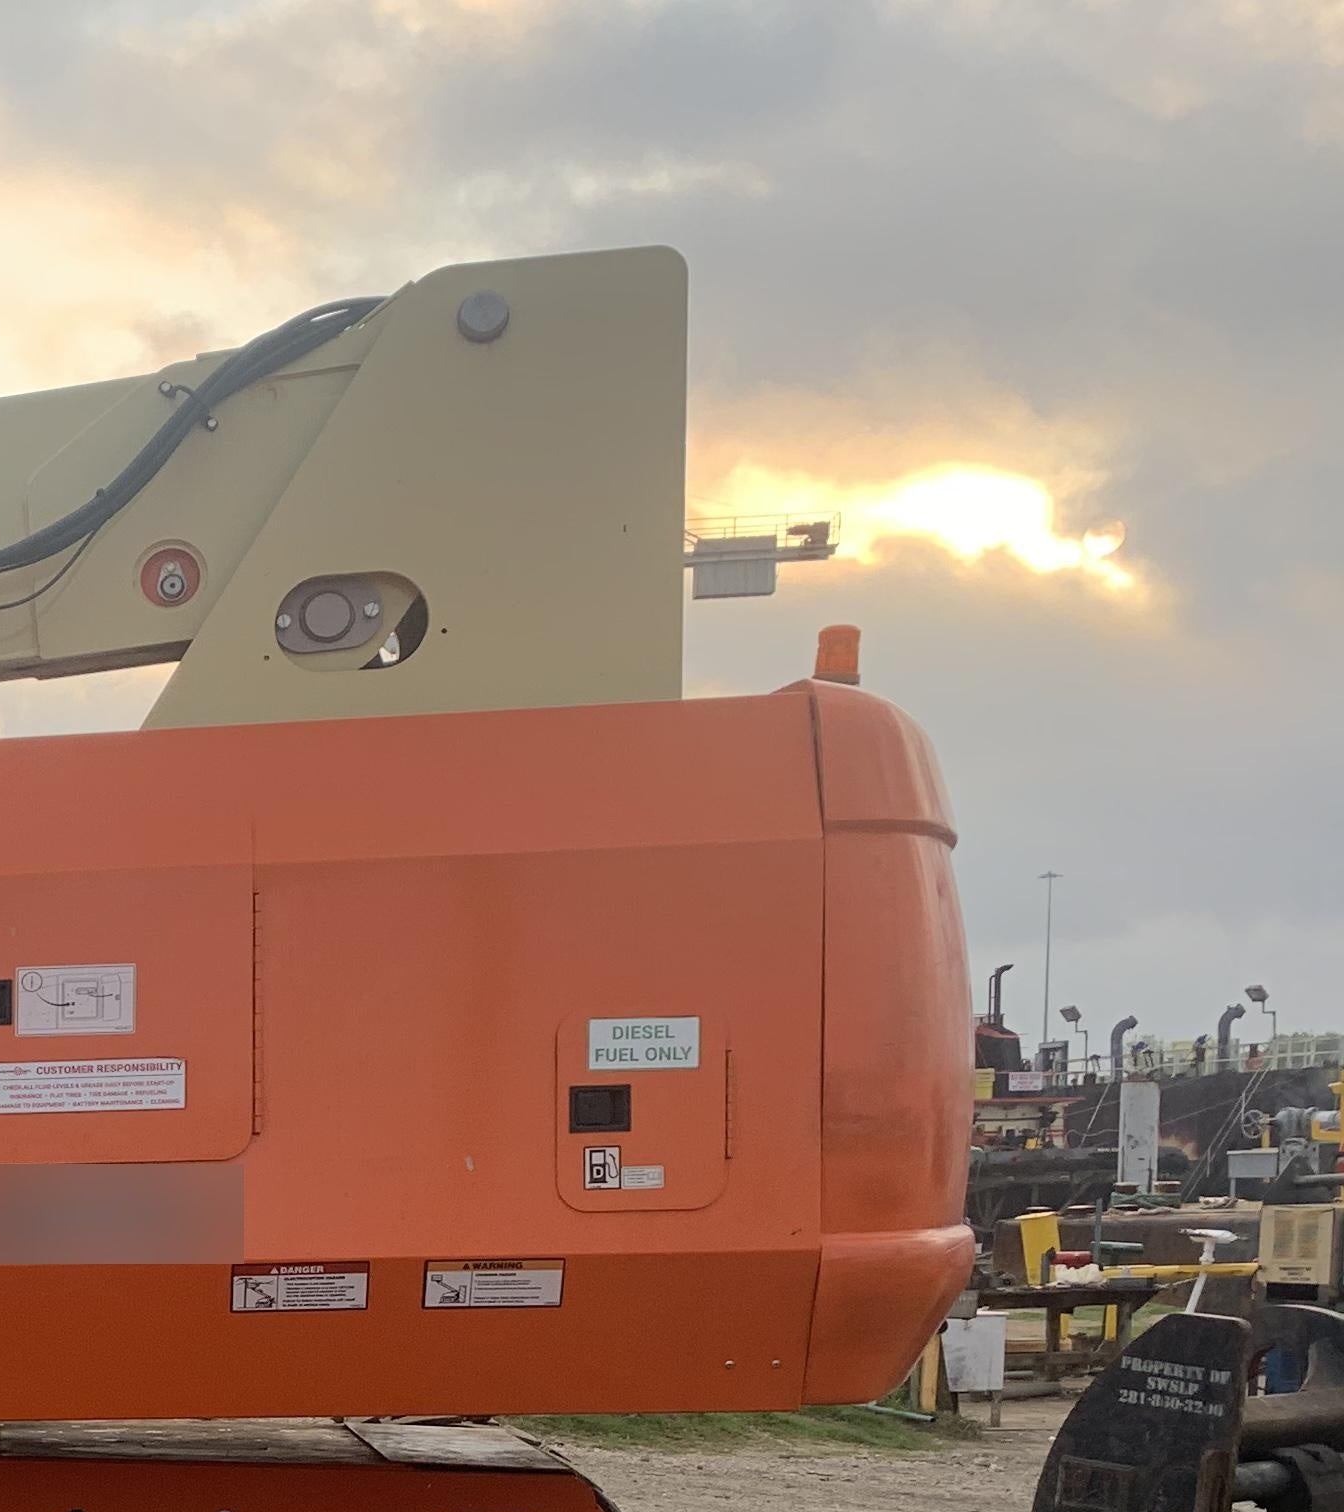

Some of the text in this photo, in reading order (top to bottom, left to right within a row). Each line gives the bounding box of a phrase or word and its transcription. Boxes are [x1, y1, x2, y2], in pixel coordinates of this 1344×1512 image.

[612, 1025, 675, 1040] DIESEL
[595, 1046, 692, 1062] FUEL ONLY
[36, 1065, 94, 1076] CUSTOMER
[97, 1062, 182, 1074] RESPONSIBILITY
[280, 1265, 324, 1274] DANGER
[472, 1262, 523, 1270] WARNING
[1121, 1355, 1232, 1385] PROPERTY OF
